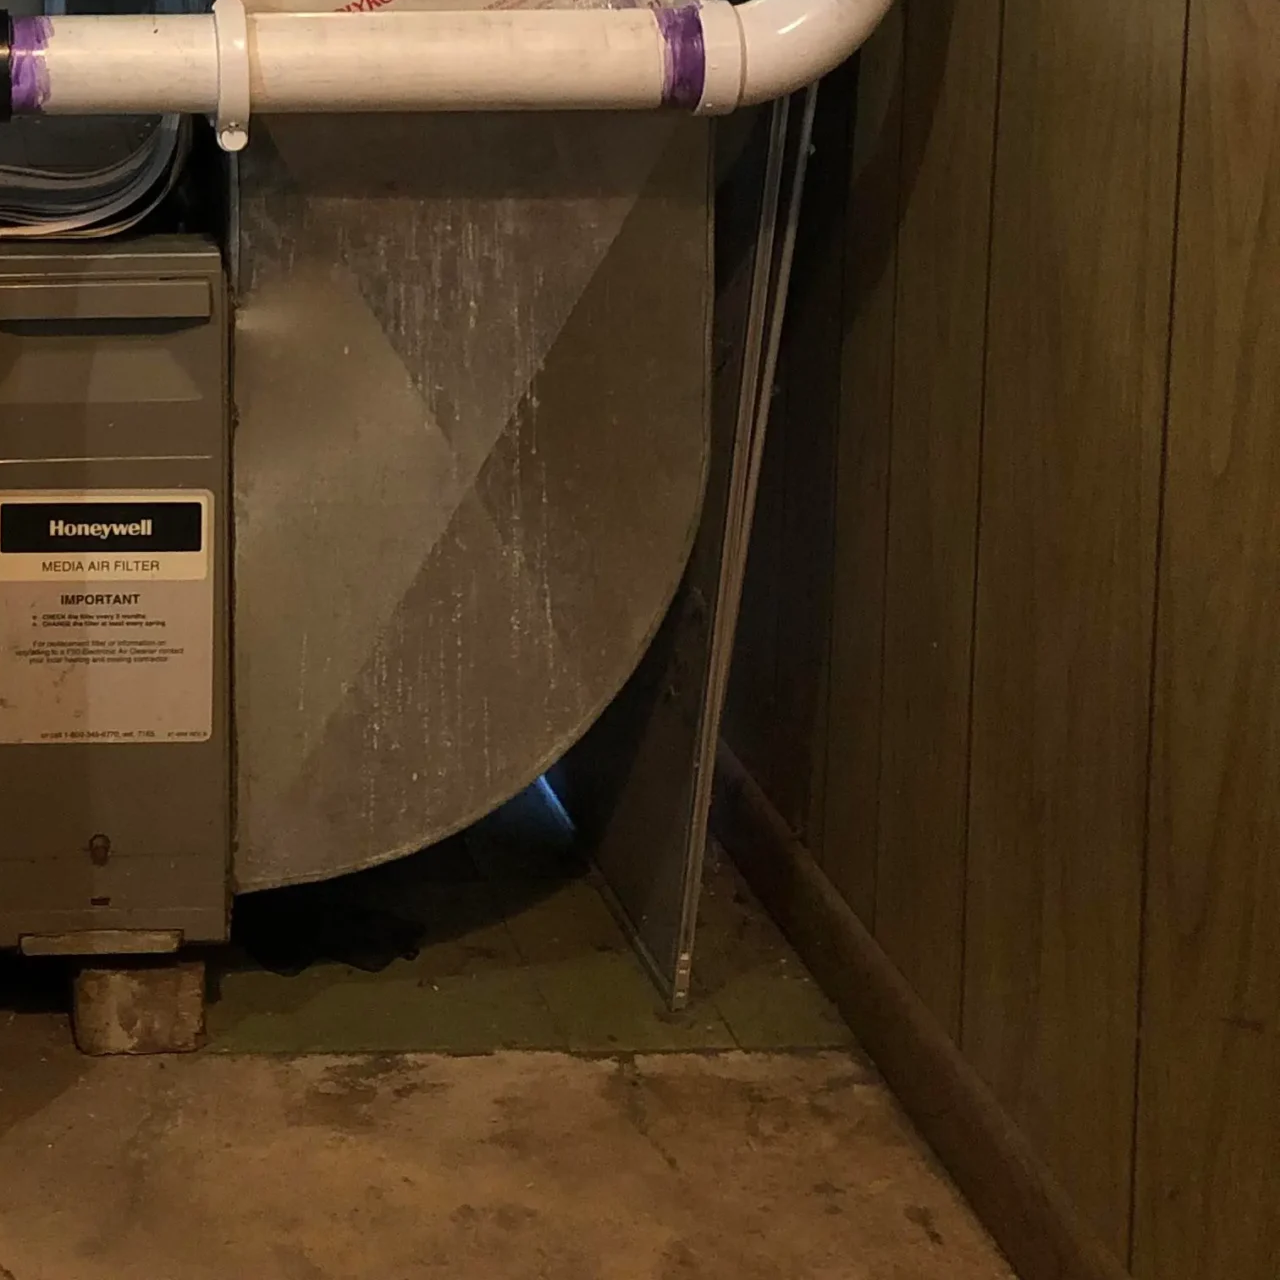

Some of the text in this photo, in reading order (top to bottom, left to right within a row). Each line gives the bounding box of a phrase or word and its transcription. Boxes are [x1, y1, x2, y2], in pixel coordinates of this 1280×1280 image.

[49, 519, 153, 540] Honeywell
[41, 560, 160, 572] MEDIA AIR FILTER
[60, 593, 141, 605] IMPORTANT
